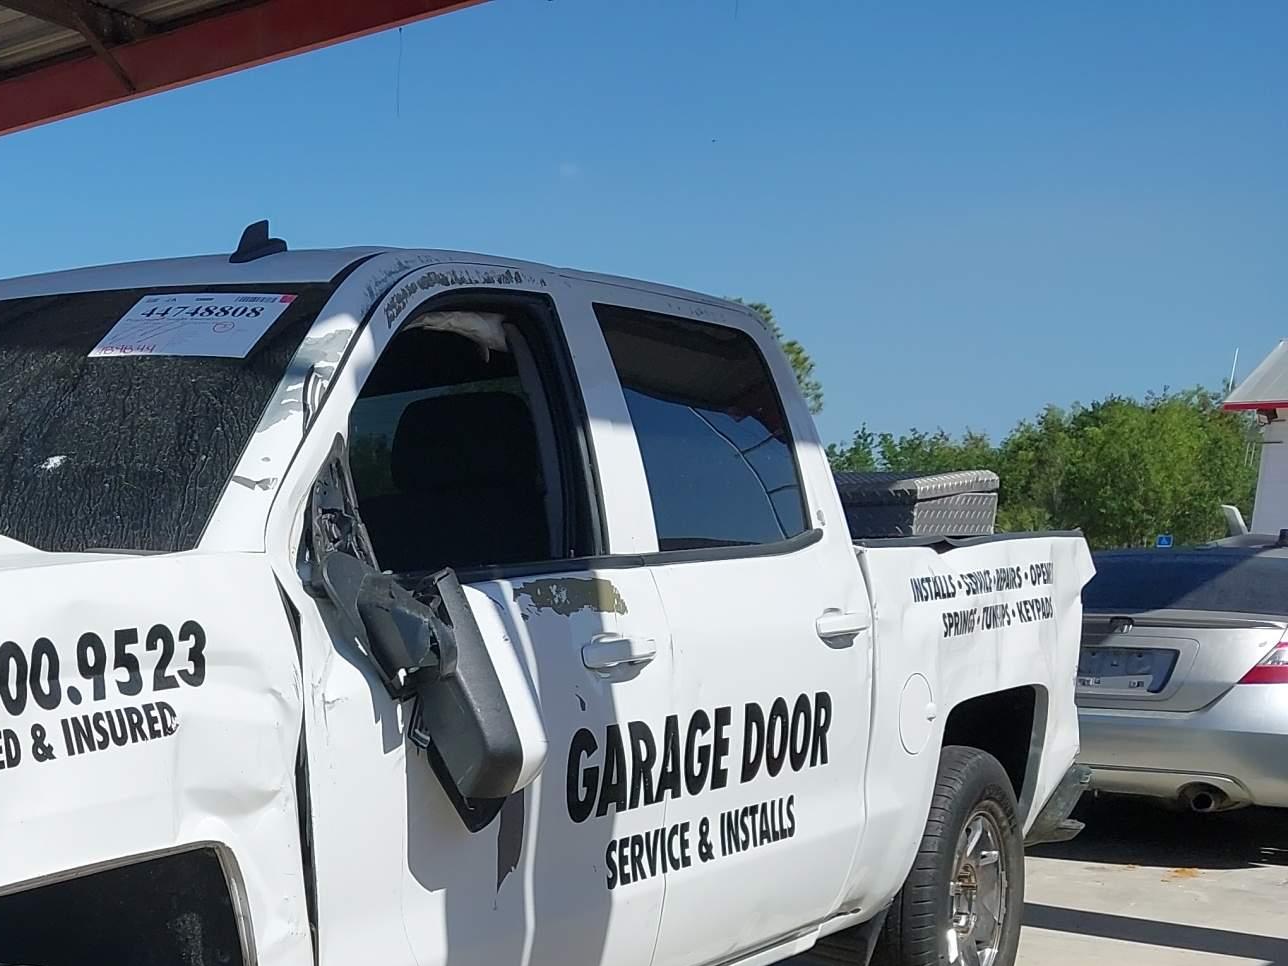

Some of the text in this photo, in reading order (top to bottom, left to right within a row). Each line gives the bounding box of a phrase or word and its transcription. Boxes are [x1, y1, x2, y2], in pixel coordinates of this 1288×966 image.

[141, 305, 265, 318] 44748808
[910, 574, 957, 602] INSTALLS
[1016, 596, 1054, 623] KEYPADS
[30, 723, 56, 763] &
[60, 701, 180, 757] INSURED
[566, 691, 832, 823] GARAGE DOOR
[605, 794, 796, 890] SERVICE & INSTALLS
